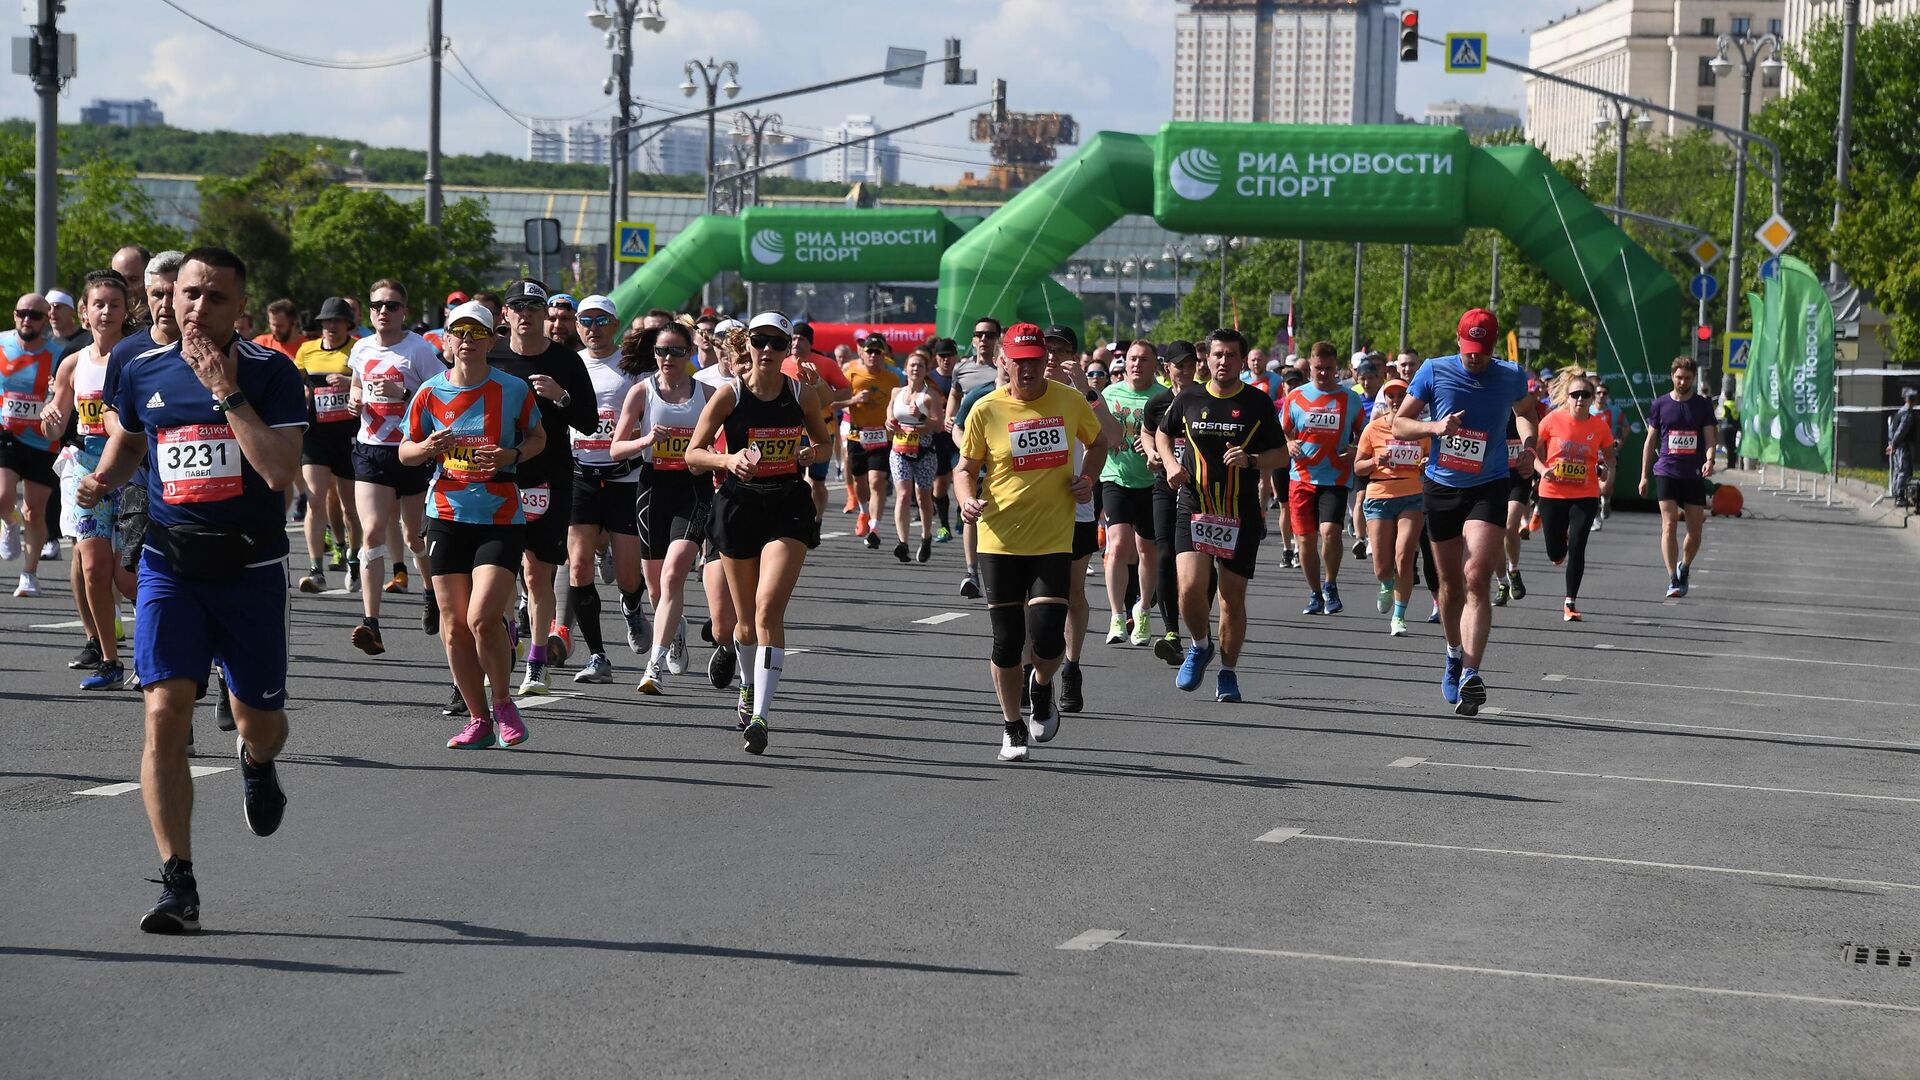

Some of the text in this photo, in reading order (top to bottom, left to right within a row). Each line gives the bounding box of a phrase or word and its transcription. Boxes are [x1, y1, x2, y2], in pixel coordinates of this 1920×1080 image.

[1238, 152, 1454, 174] РИА НОВОСТИ
[1236, 176, 1336, 197] СПОРТ
[795, 229, 937, 246] РИА НОВОСТИ
[795, 247, 862, 262] СПОРТ
[878, 327, 925, 342] zimut
[7, 400, 37, 415] 9291
[1309, 413, 1336, 425] 2710
[863, 431, 884, 440] 9323
[1018, 429, 1060, 448] 6588
[1672, 436, 1695, 446] 4469
[757, 439, 796, 456] 7597
[1445, 436, 1481, 454] 3595
[167, 442, 227, 470] 3231
[185, 468, 211, 478] ПАВЕЛ
[167, 482, 176, 496] D
[1195, 523, 1233, 542] 8626
